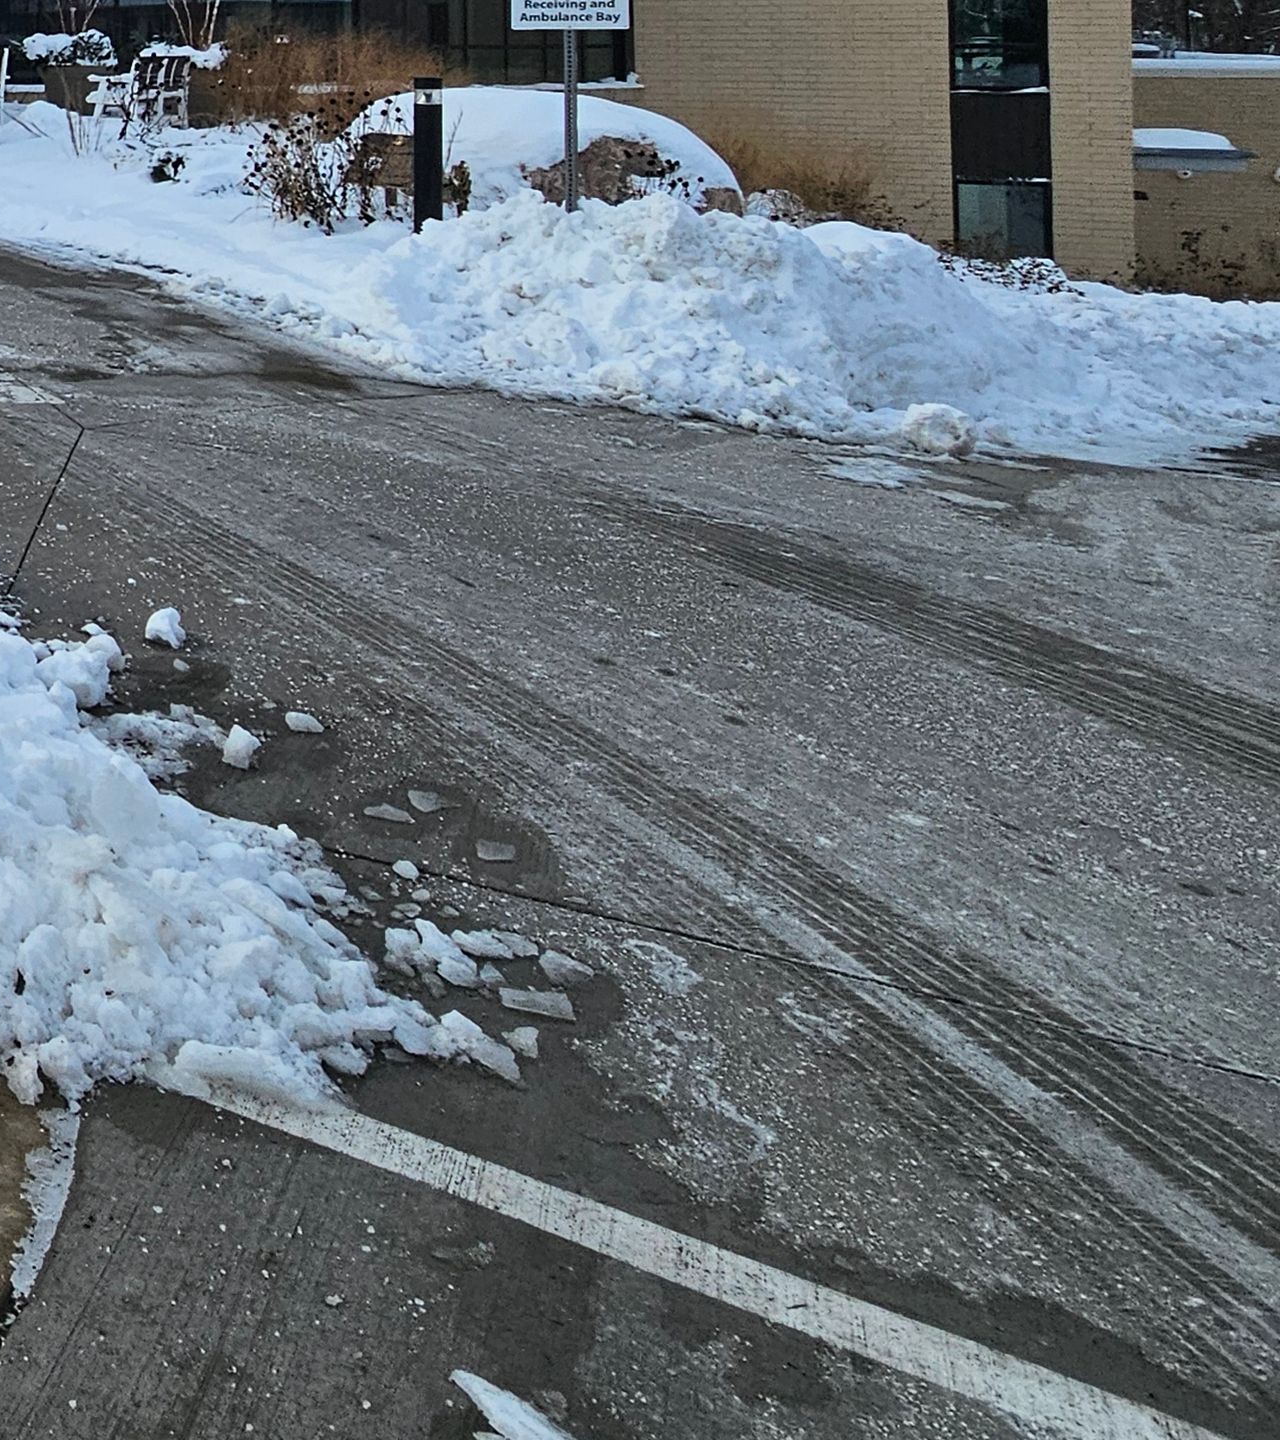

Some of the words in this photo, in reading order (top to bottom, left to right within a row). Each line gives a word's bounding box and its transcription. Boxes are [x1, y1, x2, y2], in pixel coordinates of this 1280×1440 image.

[524, 0, 587, 10] Receiving
[590, 0, 615, 8] and
[520, 12, 593, 22] Ambulance
[596, 12, 621, 23] Bay
